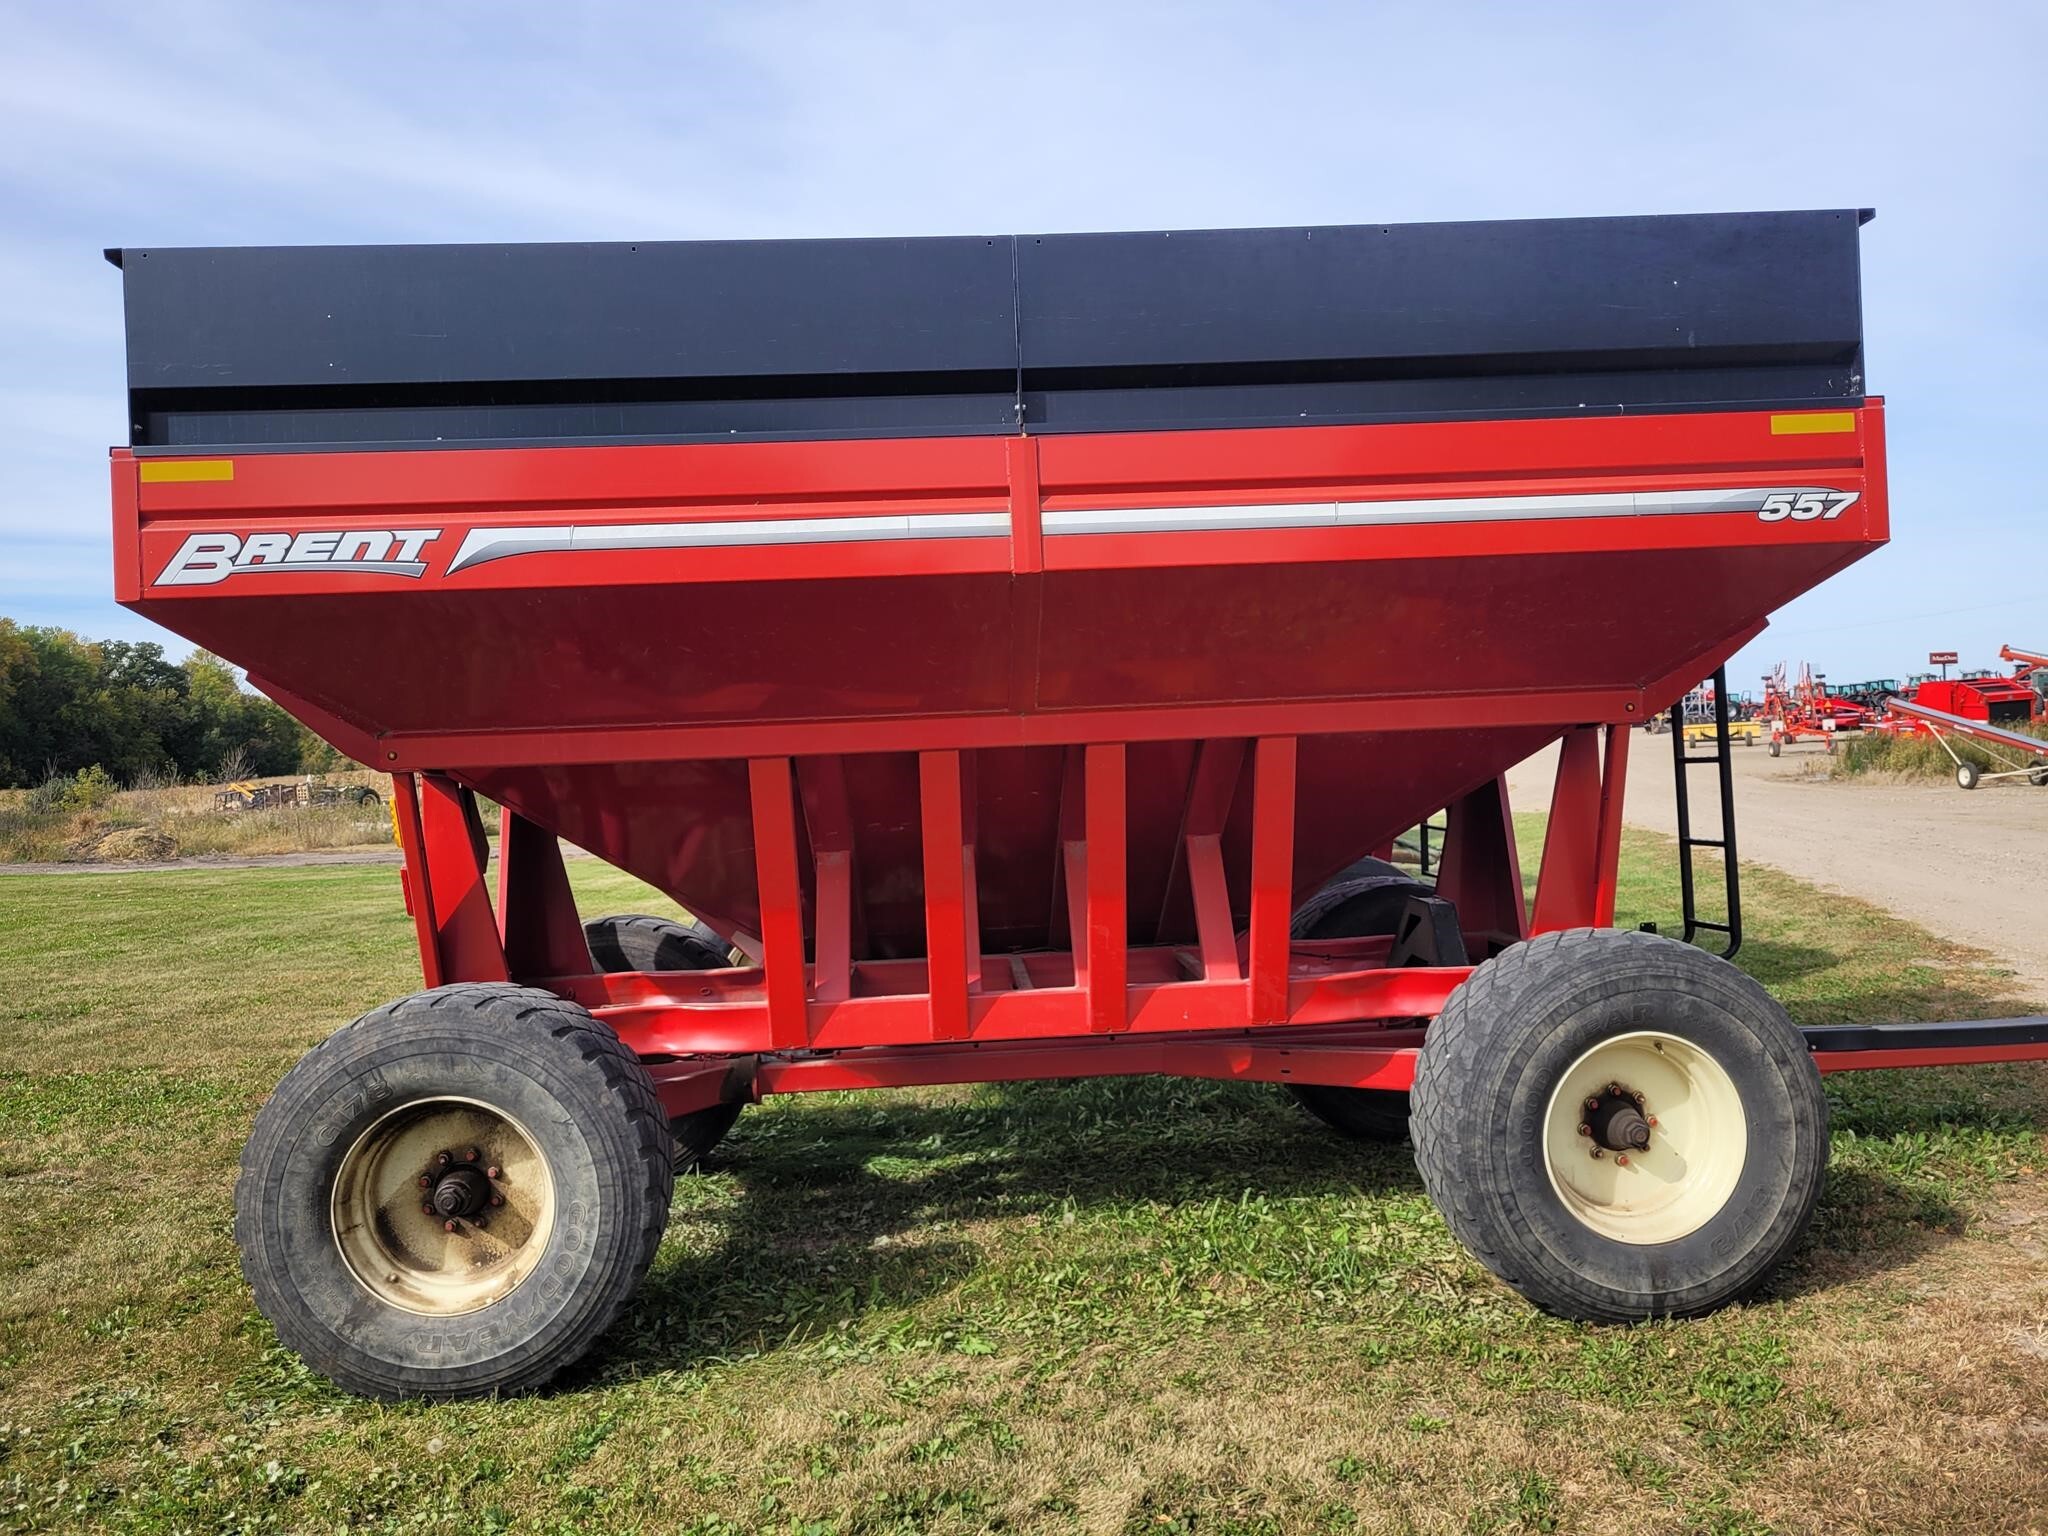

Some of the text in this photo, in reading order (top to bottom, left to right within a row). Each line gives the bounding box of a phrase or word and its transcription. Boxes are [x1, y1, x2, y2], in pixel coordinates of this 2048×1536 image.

[1758, 491, 1861, 522] 557
[152, 528, 444, 587] BRENT
[317, 1079, 394, 1147] G178
[416, 1200, 588, 1354] GOODYEAR
